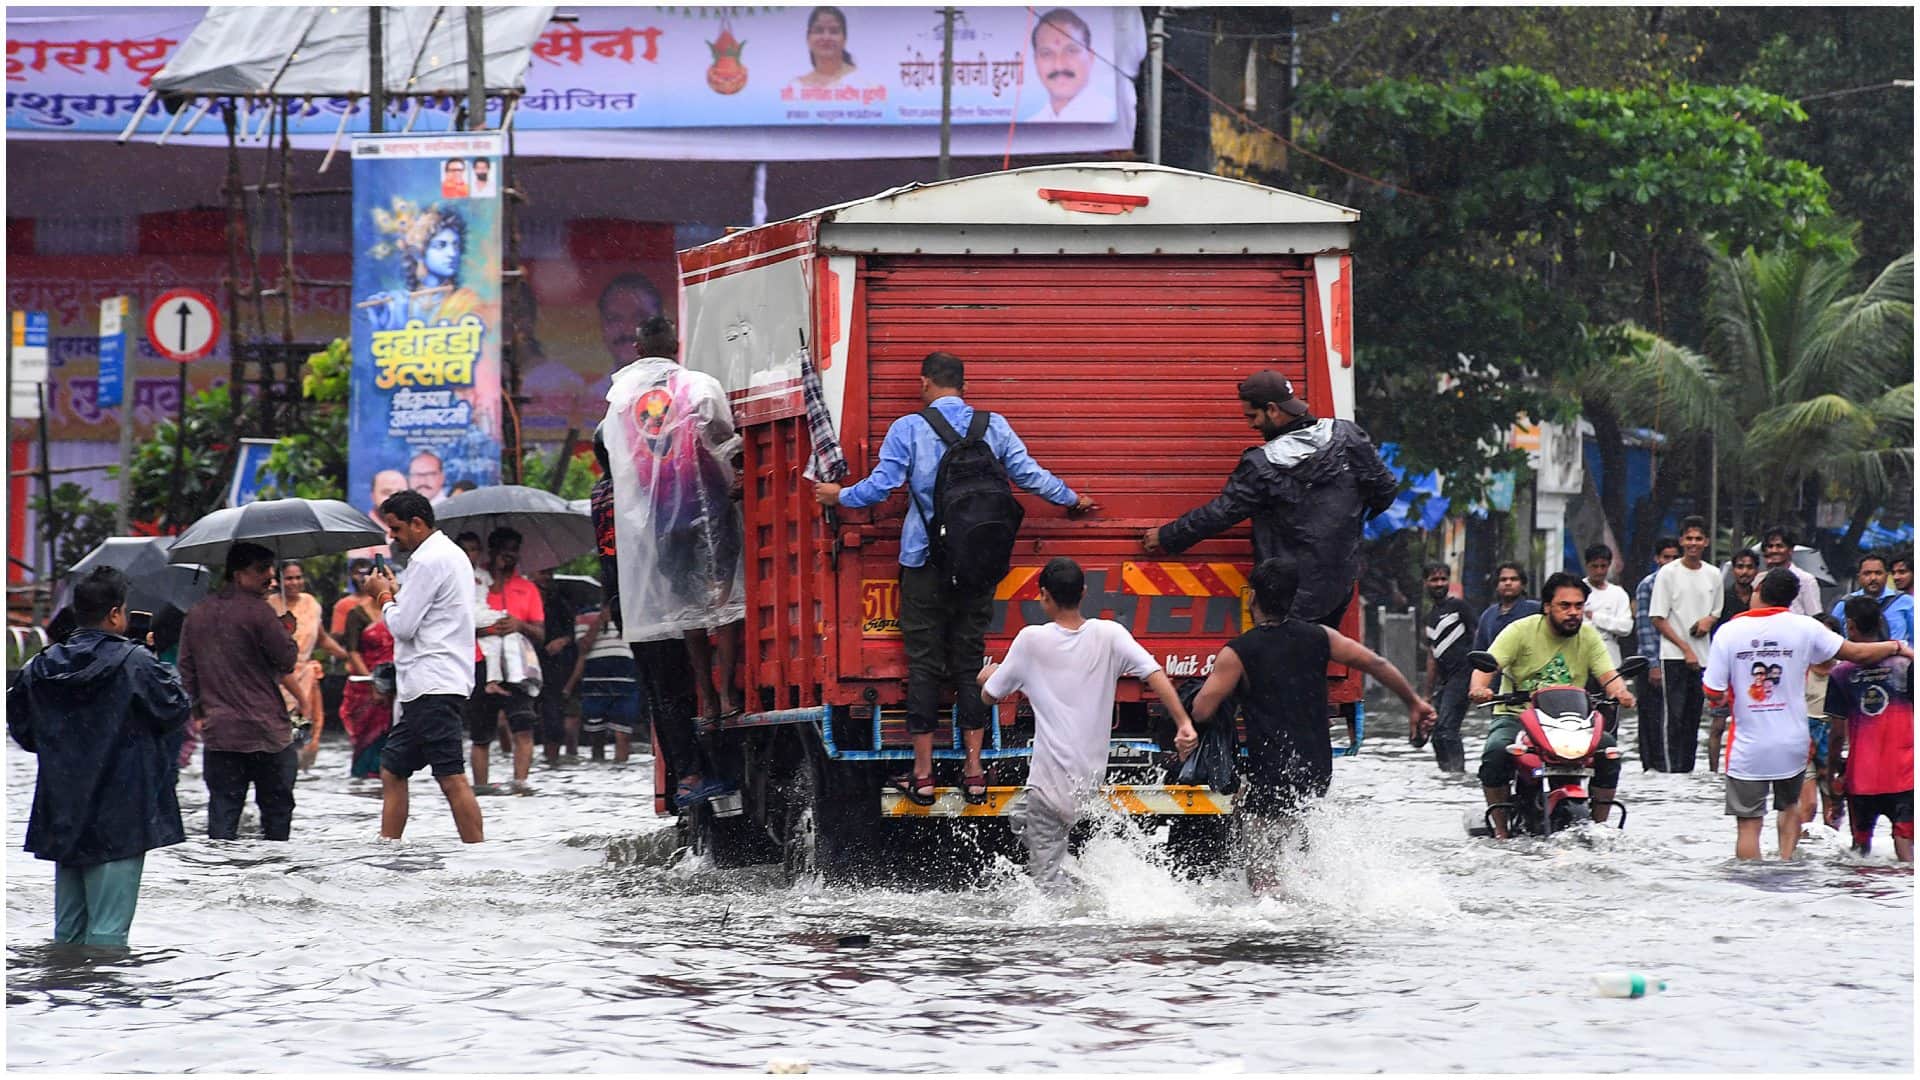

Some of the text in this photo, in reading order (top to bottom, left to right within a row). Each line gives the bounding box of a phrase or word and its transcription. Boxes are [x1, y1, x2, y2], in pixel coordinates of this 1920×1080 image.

[371, 316, 483, 358] दहीहंडी
[375, 353, 475, 389] उत्सव
[1166, 654, 1200, 676] Wait
